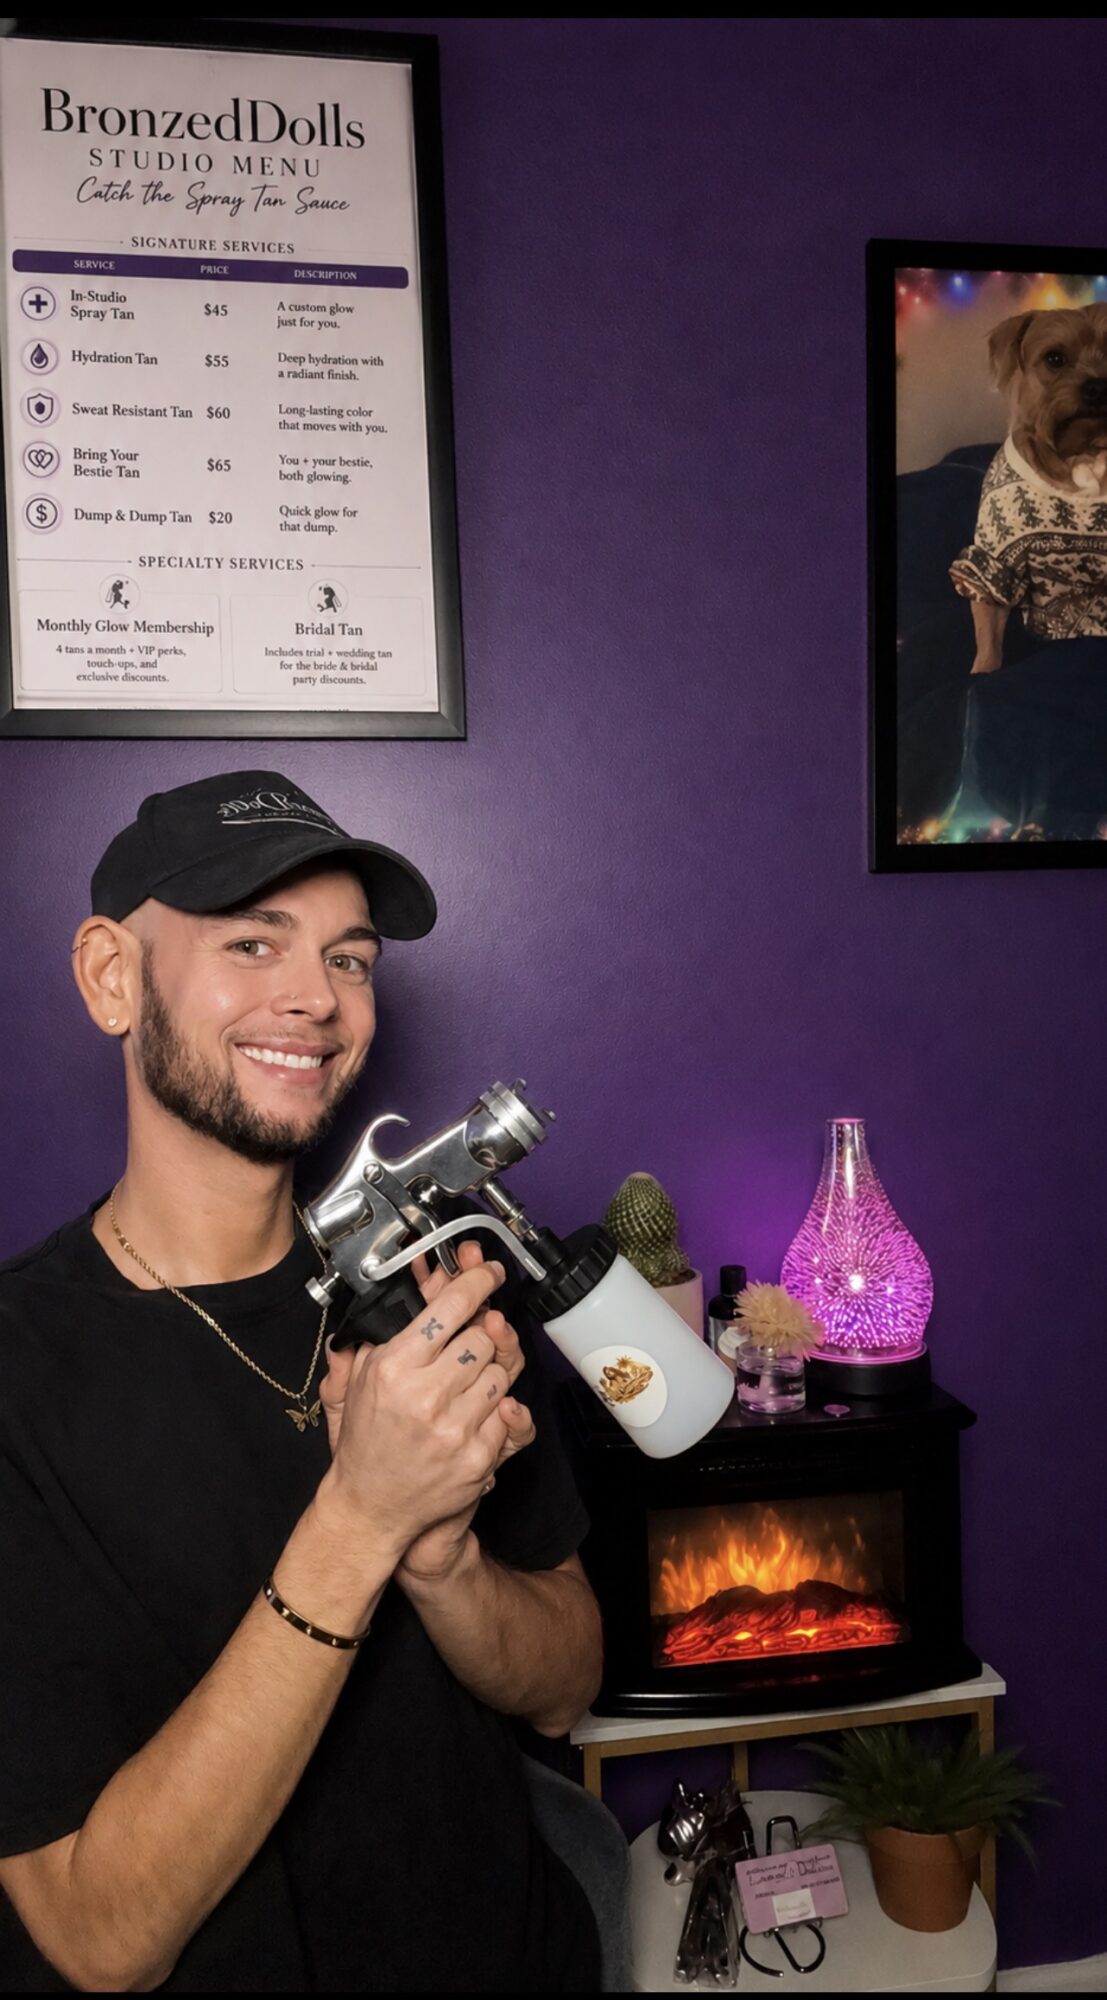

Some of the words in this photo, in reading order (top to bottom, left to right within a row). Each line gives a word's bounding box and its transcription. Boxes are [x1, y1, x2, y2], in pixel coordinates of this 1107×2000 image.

[41, 88, 365, 149] BronzedDolls
[90, 148, 213, 172] STUDIO
[234, 156, 319, 177] MENU
[77, 176, 134, 203] Catch
[141, 181, 174, 205] the
[185, 181, 245, 217] Spray
[251, 184, 286, 212] Tan
[295, 186, 350, 214] Sauce
[132, 236, 216, 251] SIGNATURE
[223, 241, 294, 254] SERVICES
[74, 260, 115, 269] SERVICE
[201, 265, 229, 274] PRICE
[294, 269, 357, 279] DESCRIPTION
[71, 289, 127, 303] In-Studio
[71, 306, 107, 321] Spray
[112, 308, 134, 320] Tan
[204, 303, 228, 316] $45
[277, 301, 285, 311] A
[288, 304, 326, 312] custom
[329, 303, 354, 316] glow
[277, 316, 296, 328] just
[300, 317, 315, 327] for
[318, 321, 340, 330] you.
[72, 350, 133, 365] Hydration
[135, 353, 158, 365] Tan
[205, 354, 229, 367] $55
[278, 352, 306, 366] Deep
[308, 353, 358, 367] hydration
[361, 356, 384, 366] with
[287, 369, 324, 379] radiant
[327, 369, 359, 380] finish.
[72, 403, 108, 415] Sweat
[112, 404, 167, 417] Resistant
[170, 406, 193, 418] Tan
[207, 406, 230, 419] $60
[279, 404, 344, 420] Long-lasting
[346, 406, 373, 417] color
[279, 419, 299, 430] that
[303, 423, 336, 431] moves
[339, 422, 362, 432] with
[365, 425, 388, 435] you.
[74, 448, 108, 463] Bring
[110, 449, 139, 461] Your
[279, 454, 299, 465] You
[312, 459, 337, 469] your
[339, 456, 373, 468] bestie,
[74, 464, 113, 477] Bestie
[116, 465, 140, 478] Tan
[208, 458, 231, 472] $65
[279, 470, 303, 481] both
[307, 471, 351, 485] glowing.
[74, 508, 112, 524] Dump
[115, 509, 125, 521] &
[130, 510, 167, 525] Dump
[169, 511, 192, 523] Tan
[209, 511, 232, 524] $20
[279, 505, 310, 518] Quick
[315, 507, 338, 519] glow
[343, 509, 359, 518] for
[280, 521, 301, 531] that
[304, 521, 337, 535] dump.
[139, 556, 224, 569] SPECIALTY
[230, 558, 303, 570] SERVICES
[37, 619, 91, 635] Monthly
[95, 620, 129, 632] Glow
[134, 620, 214, 637] Membership
[295, 622, 335, 635] Bridal
[338, 623, 363, 636] Tan
[56, 645, 62, 653] 4
[65, 646, 85, 654] tans
[95, 645, 126, 654] month
[138, 645, 155, 655] VIP
[158, 646, 186, 658] perks,
[265, 647, 304, 657] Includes
[306, 648, 324, 657] trial
[336, 648, 376, 660] wedding
[87, 659, 138, 670] touch-ups,
[140, 659, 158, 668] and
[280, 660, 293, 670] for
[296, 661, 311, 670] the
[313, 661, 337, 670] bride
[340, 662, 348, 671] &
[350, 661, 378, 671] bridal
[76, 672, 119, 682] exclusive
[121, 672, 169, 682] discounts.
[293, 676, 317, 686] party
[320, 675, 366, 684] discounts.
